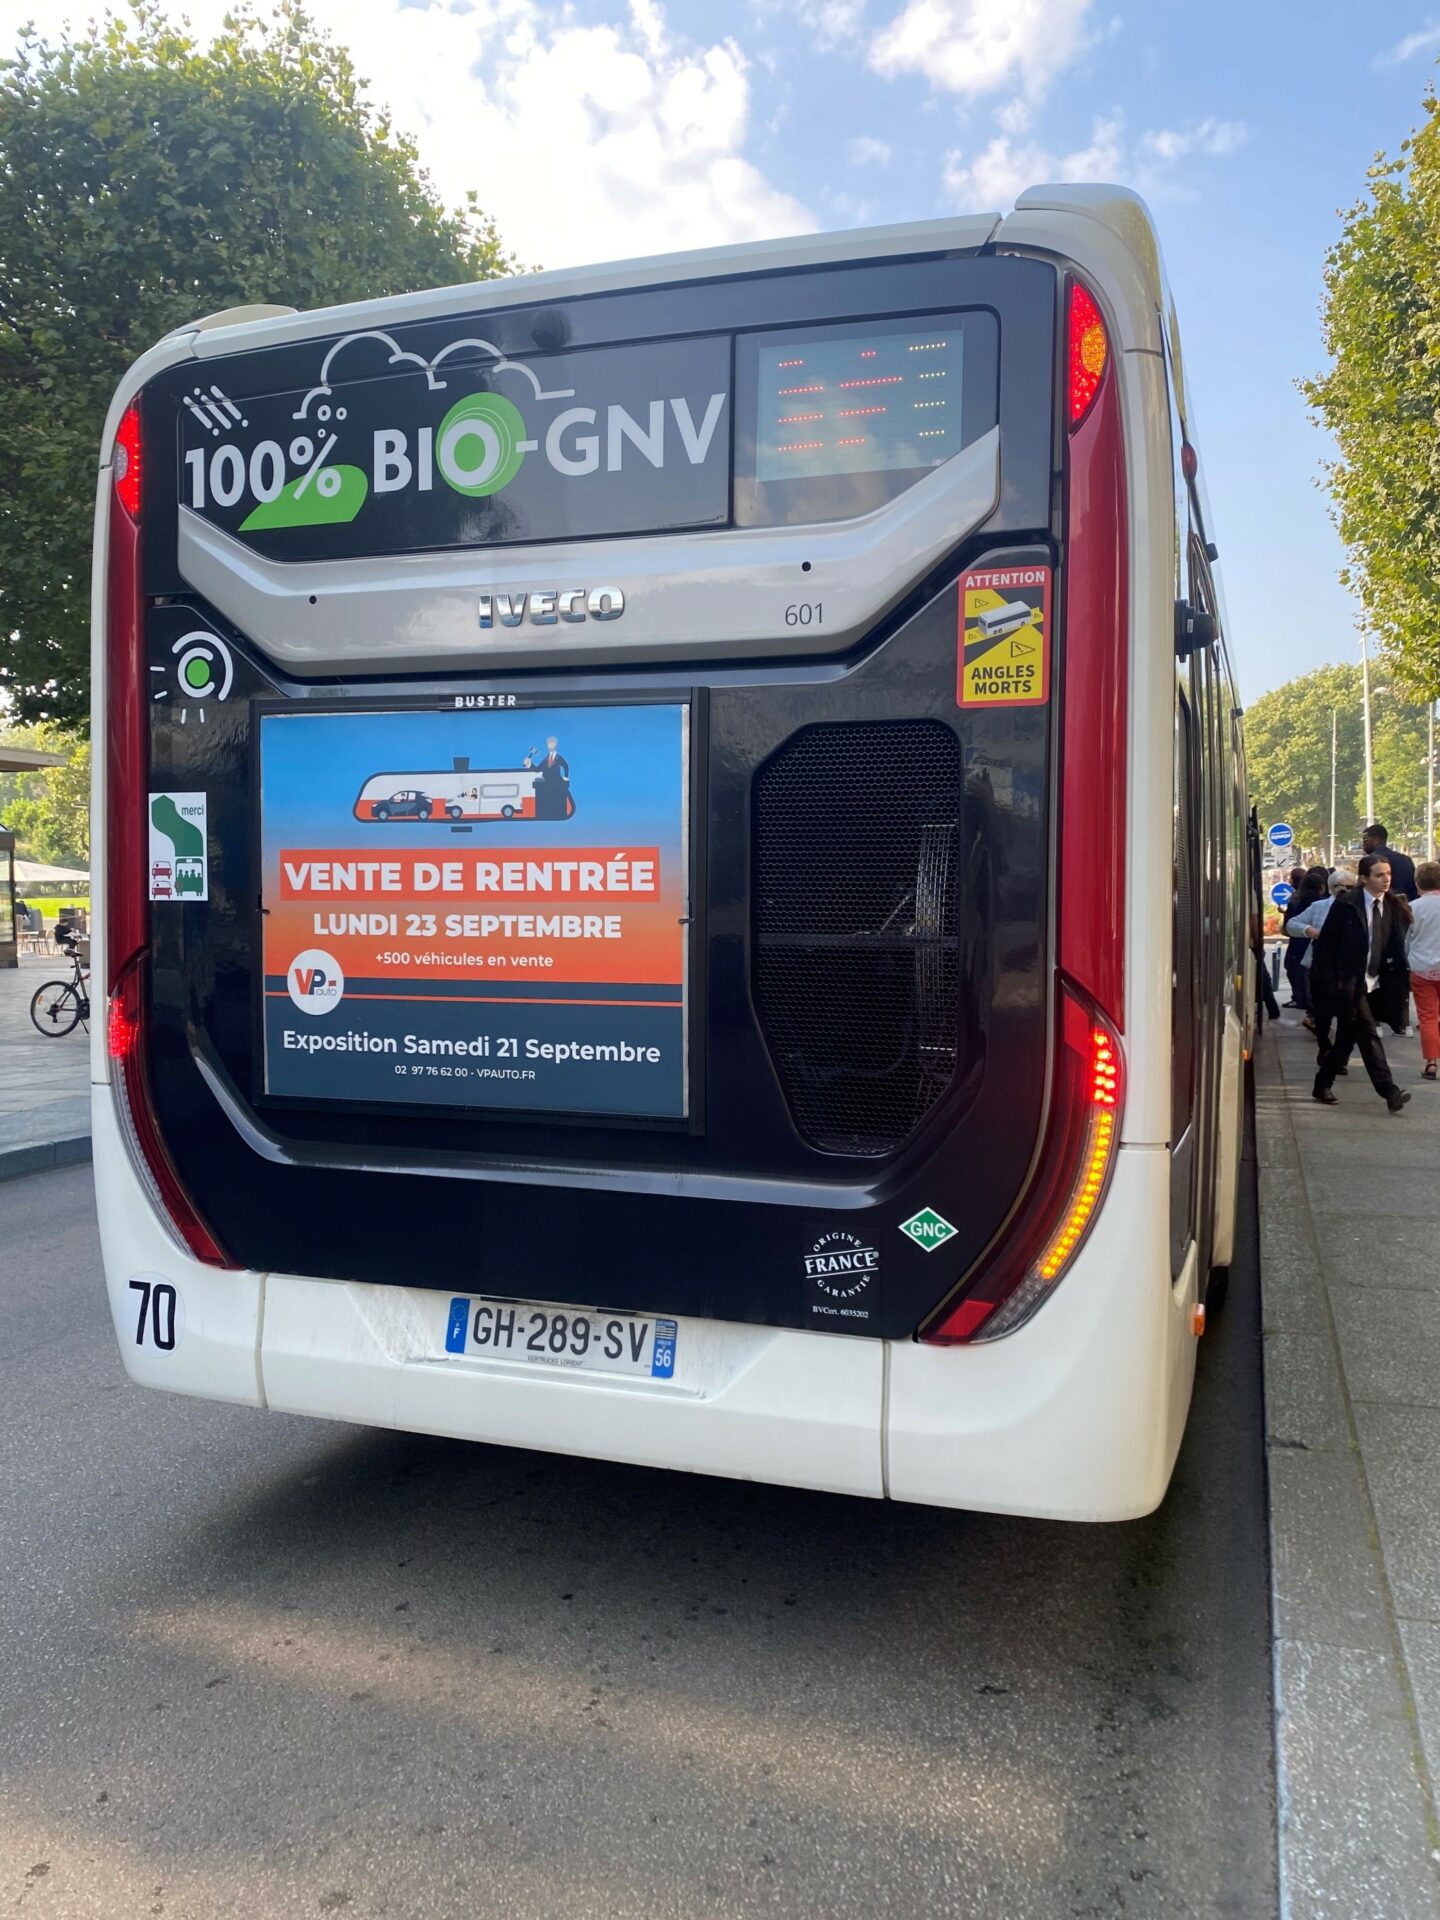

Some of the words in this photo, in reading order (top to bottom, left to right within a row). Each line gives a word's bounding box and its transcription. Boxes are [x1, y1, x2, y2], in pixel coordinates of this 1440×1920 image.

[184, 433, 342, 509] 100%
[372, 392, 727, 493] BIO-GNV
[965, 570, 1046, 588] ATTENTION
[478, 586, 627, 630] IVECO
[784, 603, 824, 626] 601
[971, 664, 1035, 680] ANGLES
[974, 680, 1032, 695] MORTS
[455, 695, 517, 709] BUSTER
[181, 804, 205, 816] merci
[283, 862, 402, 891] VENTE
[413, 862, 464, 891] DE
[476, 852, 655, 892] RENTRÉE
[313, 913, 398, 936] LUNDI
[405, 914, 437, 937] 23
[445, 914, 622, 939] SEPTEMBRE
[375, 952, 411, 965] +500
[414, 951, 484, 966] véhicules
[487, 955, 506, 967] en
[510, 954, 554, 968] vente
[294, 968, 326, 996] VP
[316, 987, 337, 997] auto
[282, 1029, 398, 1054] Exposition
[403, 1034, 491, 1057] Samedi
[496, 1038, 519, 1058] 21
[524, 1038, 661, 1065] Septembre
[394, 1065, 407, 1075] 02
[411, 1065, 424, 1076] 97
[425, 1066, 439, 1077] 76
[440, 1067, 453, 1077] 62
[454, 1067, 468, 1078] 00
[476, 1068, 537, 1080] VPAUTO.FR
[909, 1221, 947, 1238] GNC
[812, 1232, 862, 1252] ORIGINE
[816, 1274, 871, 1298] GARANTIE
[129, 1280, 176, 1351] 70
[453, 1327, 460, 1339] F
[472, 1307, 649, 1363] GH-289-SV
[654, 1348, 672, 1368] 56
